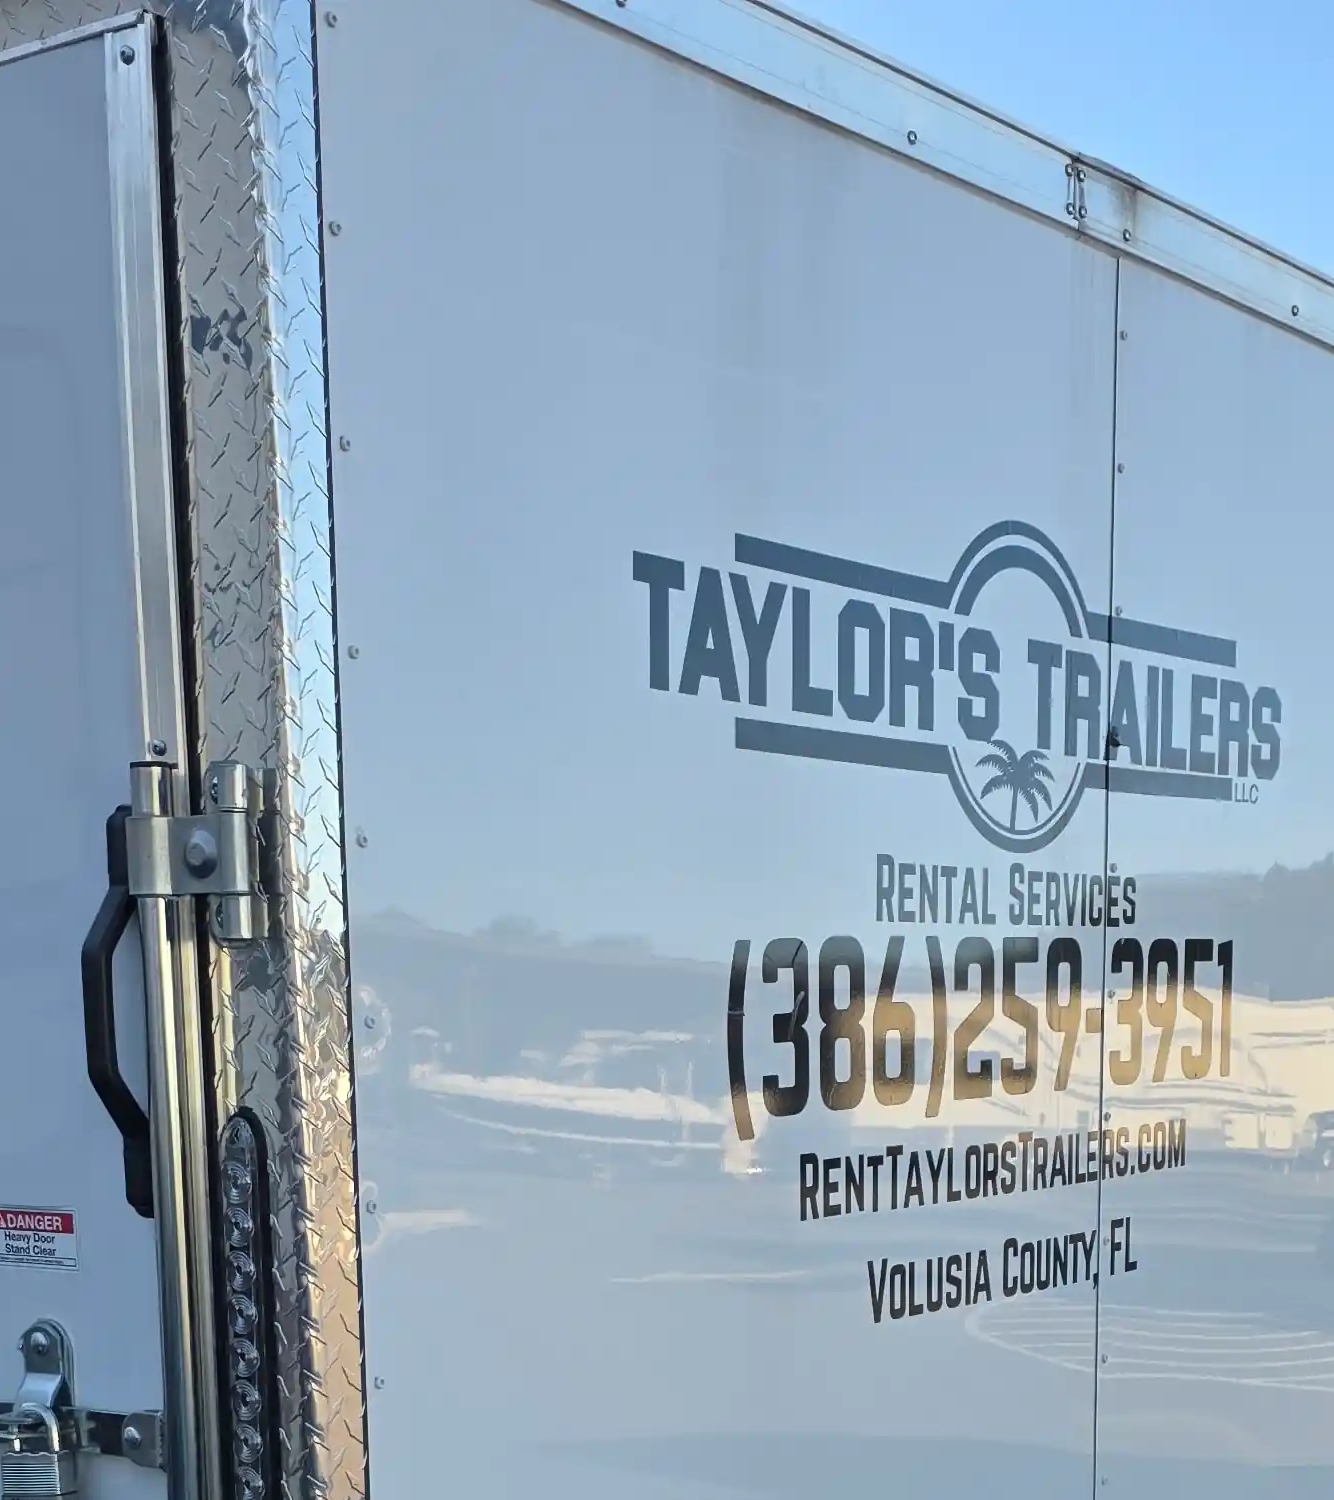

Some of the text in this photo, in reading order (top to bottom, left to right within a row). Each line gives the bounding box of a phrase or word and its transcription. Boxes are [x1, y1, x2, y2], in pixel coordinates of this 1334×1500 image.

[632, 550, 1283, 782] TAYLOR'S TRAILERS
[1233, 782, 1260, 806] LLC
[726, 934, 1234, 1142] (386)259-3951
[6, 1213, 63, 1232] DANGER
[4, 1230, 56, 1245] Heavy Door
[5, 1243, 57, 1256] Stand Clear
[1109, 1216, 1138, 1277] FL
